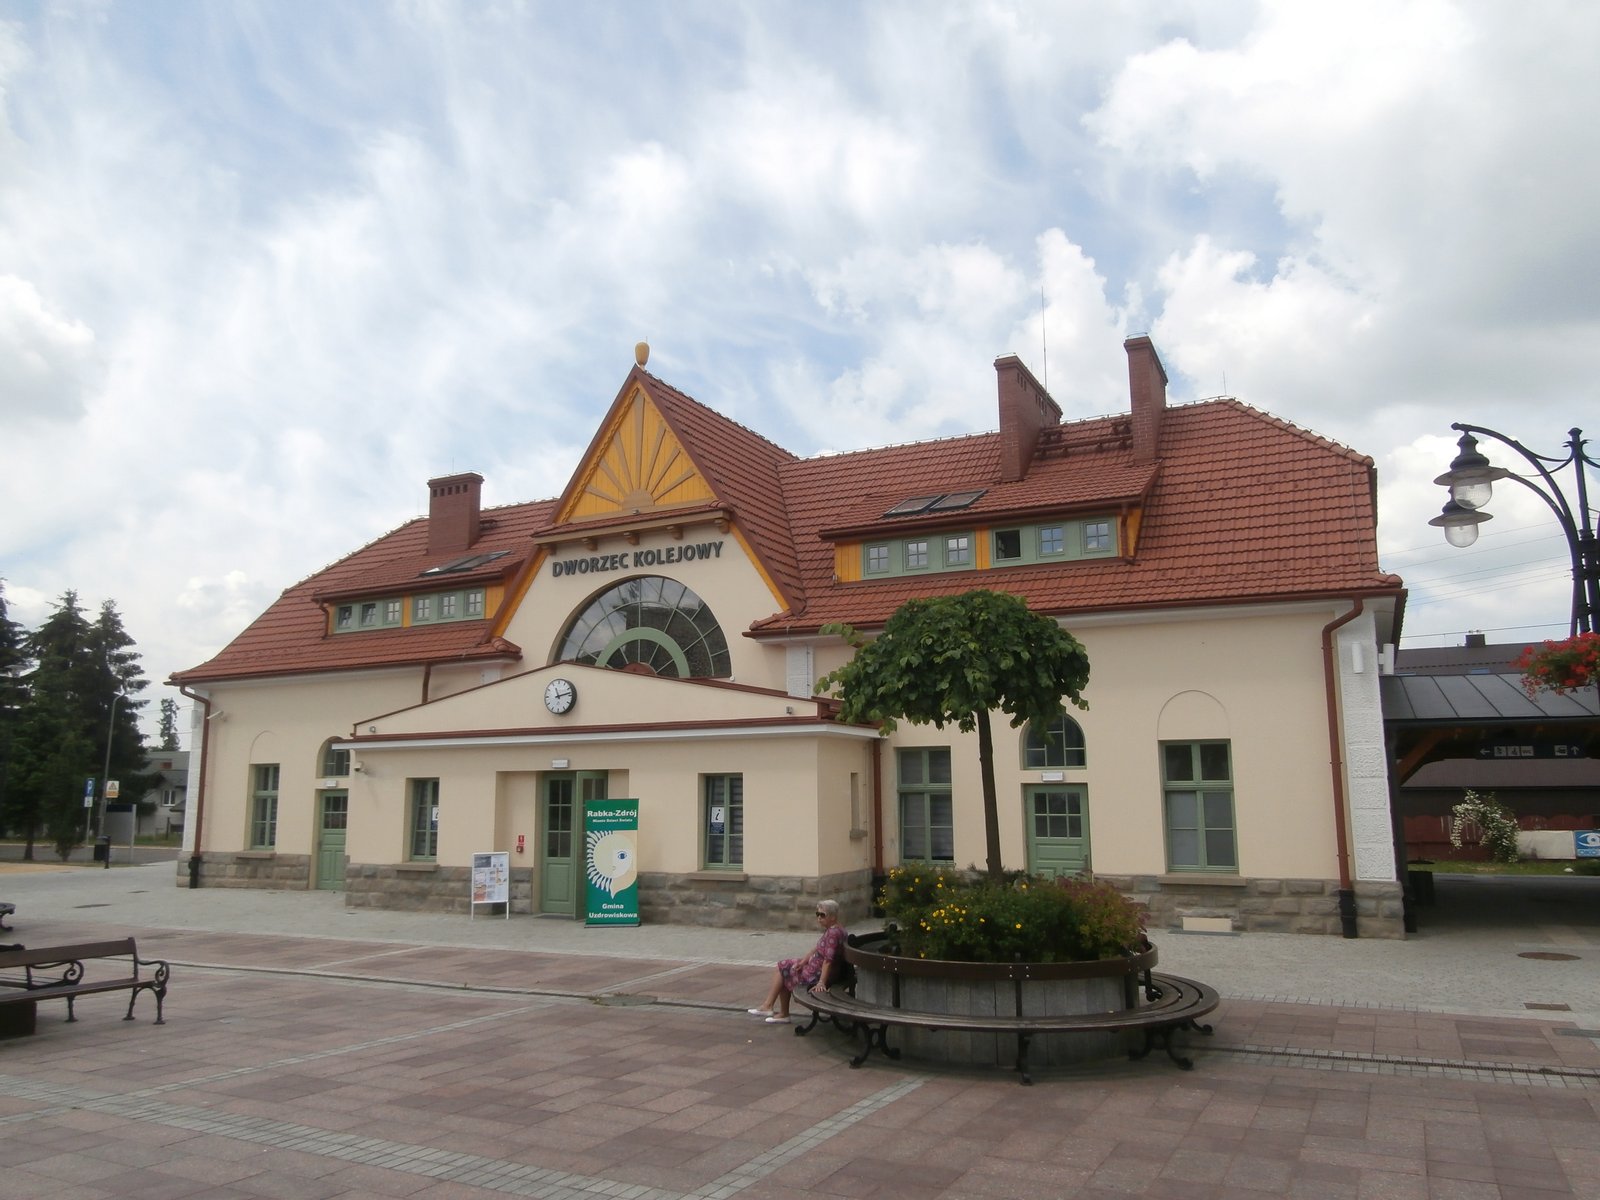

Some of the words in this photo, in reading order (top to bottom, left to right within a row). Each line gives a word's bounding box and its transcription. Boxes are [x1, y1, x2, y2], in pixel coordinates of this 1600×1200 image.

[552, 553, 629, 577] DWORZEC
[633, 541, 723, 567] KOLEJOWY
[88, 780, 92, 794] P
[587, 810, 637, 818] Rabka-Zdrój
